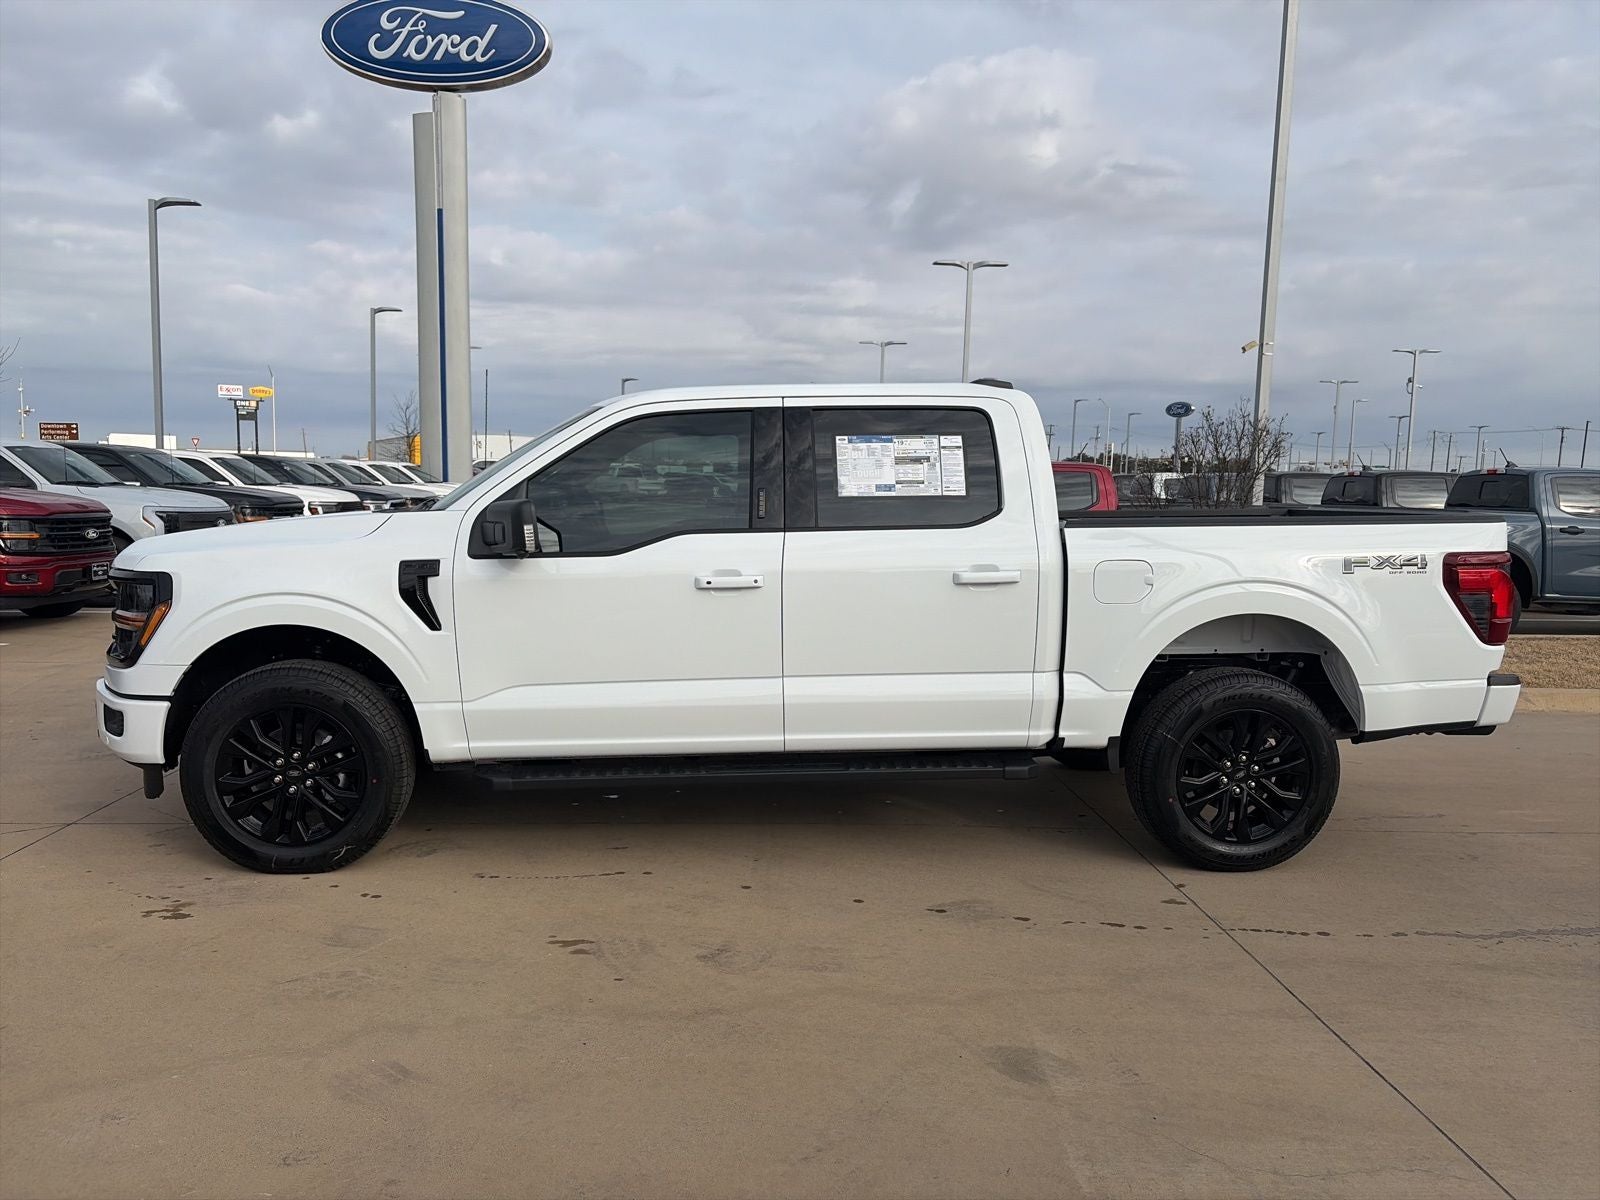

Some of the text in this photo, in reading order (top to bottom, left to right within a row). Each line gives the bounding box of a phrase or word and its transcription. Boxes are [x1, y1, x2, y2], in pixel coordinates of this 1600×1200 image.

[368, 6, 498, 63] Ford
[219, 386, 242, 394] Exxon
[1169, 404, 1186, 415] Ford
[1342, 553, 1428, 574] FX4
